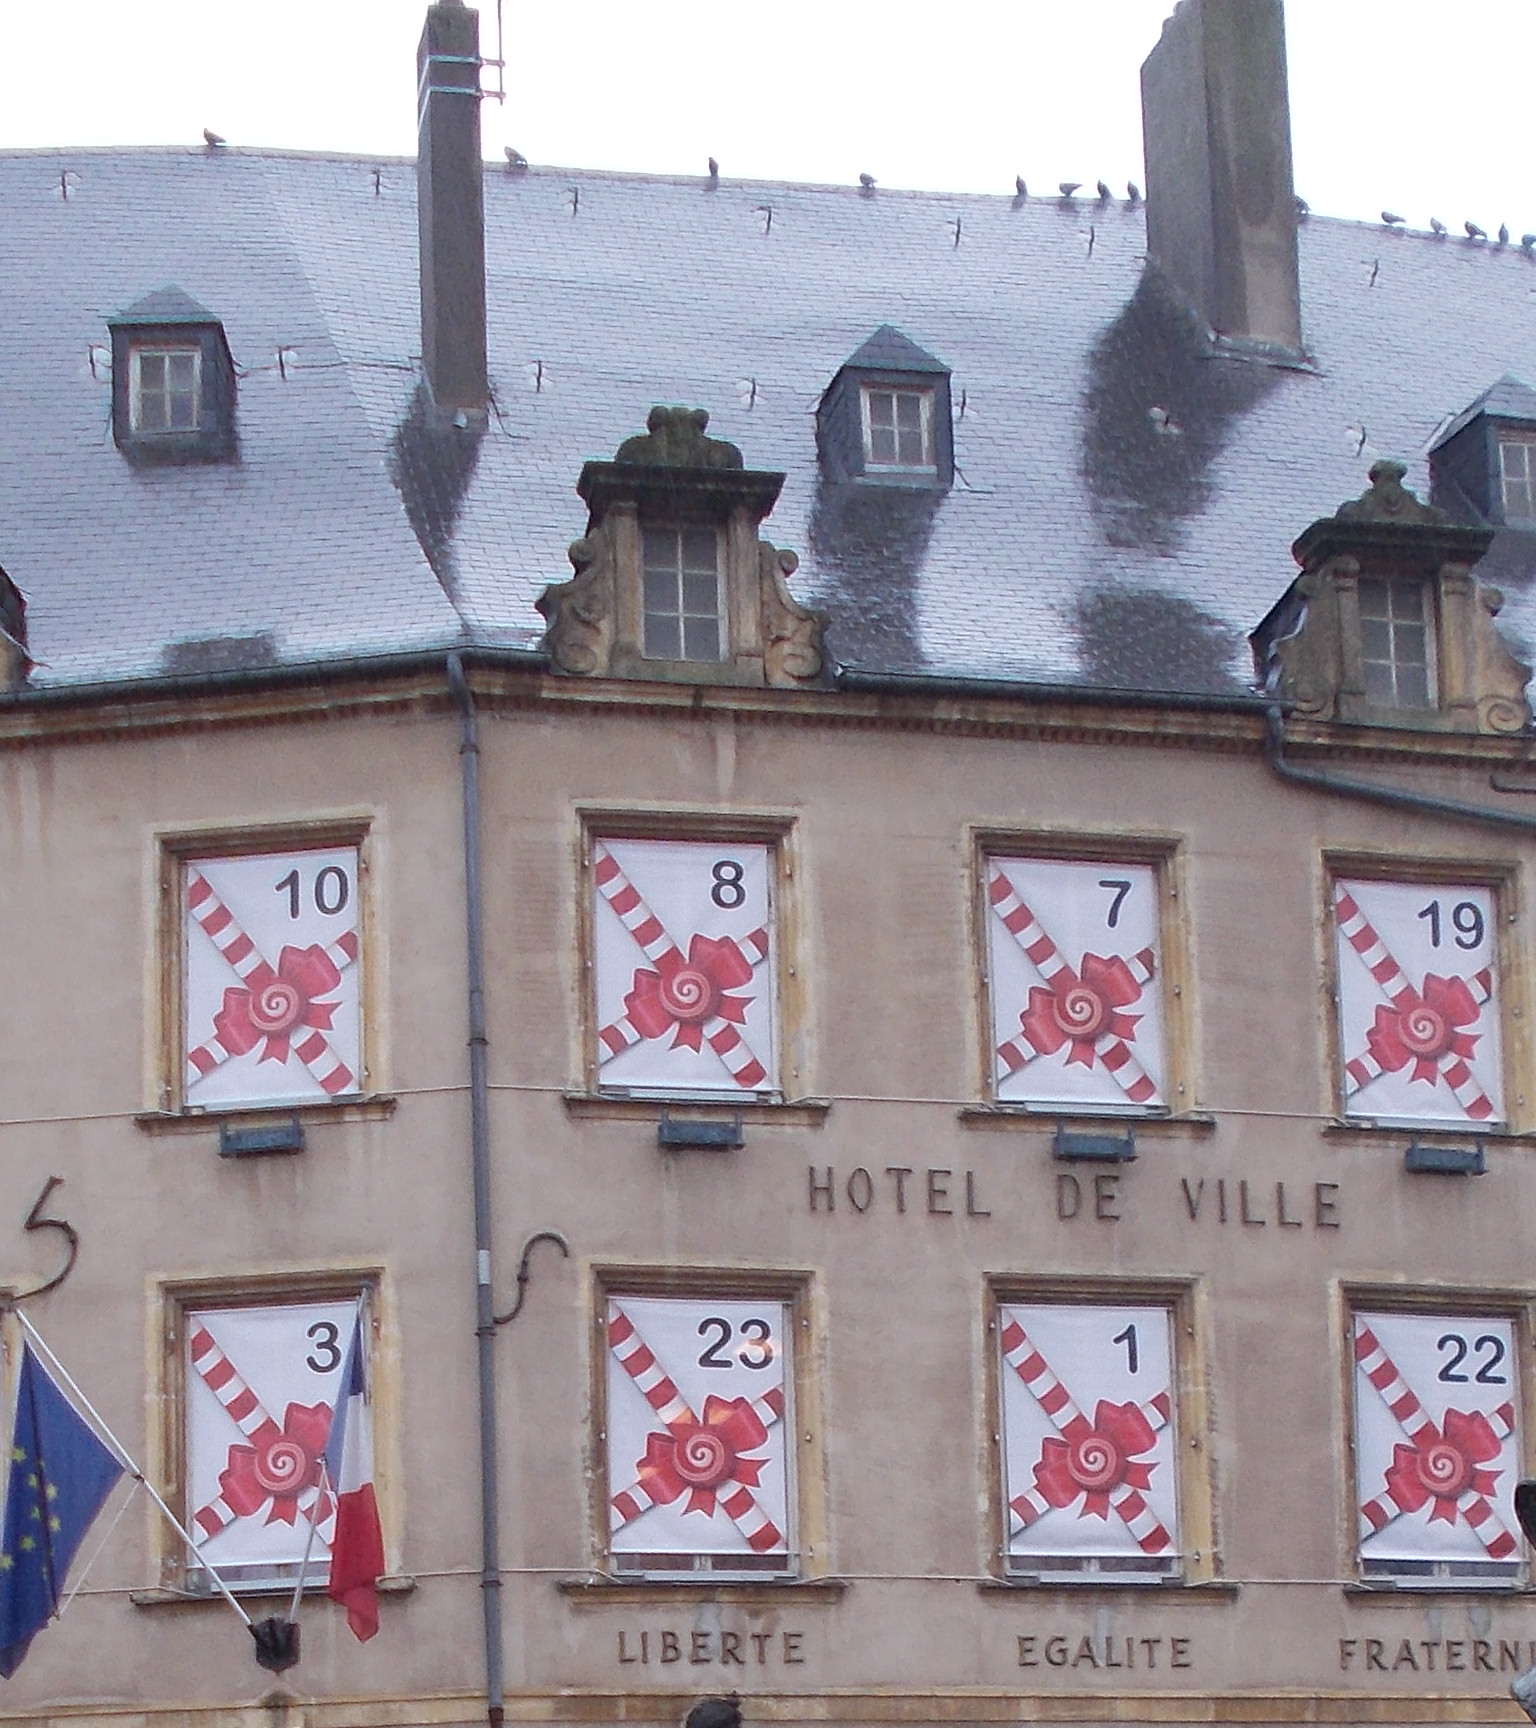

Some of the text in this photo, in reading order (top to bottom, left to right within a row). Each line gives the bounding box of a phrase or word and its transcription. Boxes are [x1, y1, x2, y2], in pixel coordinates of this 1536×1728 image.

[276, 867, 348, 918] 10
[712, 861, 745, 908] 8
[1099, 880, 1131, 927] 7
[1418, 901, 1484, 949] 19
[808, 1166, 1341, 1232] HOTEL DE VILLE
[307, 1322, 341, 1372] 3
[699, 1318, 772, 1369] 23
[1113, 1325, 1137, 1373] 1
[1438, 1335, 1506, 1384] 22
[618, 1631, 804, 1666] LIBERTE
[1017, 1636, 1192, 1669] EGALITE
